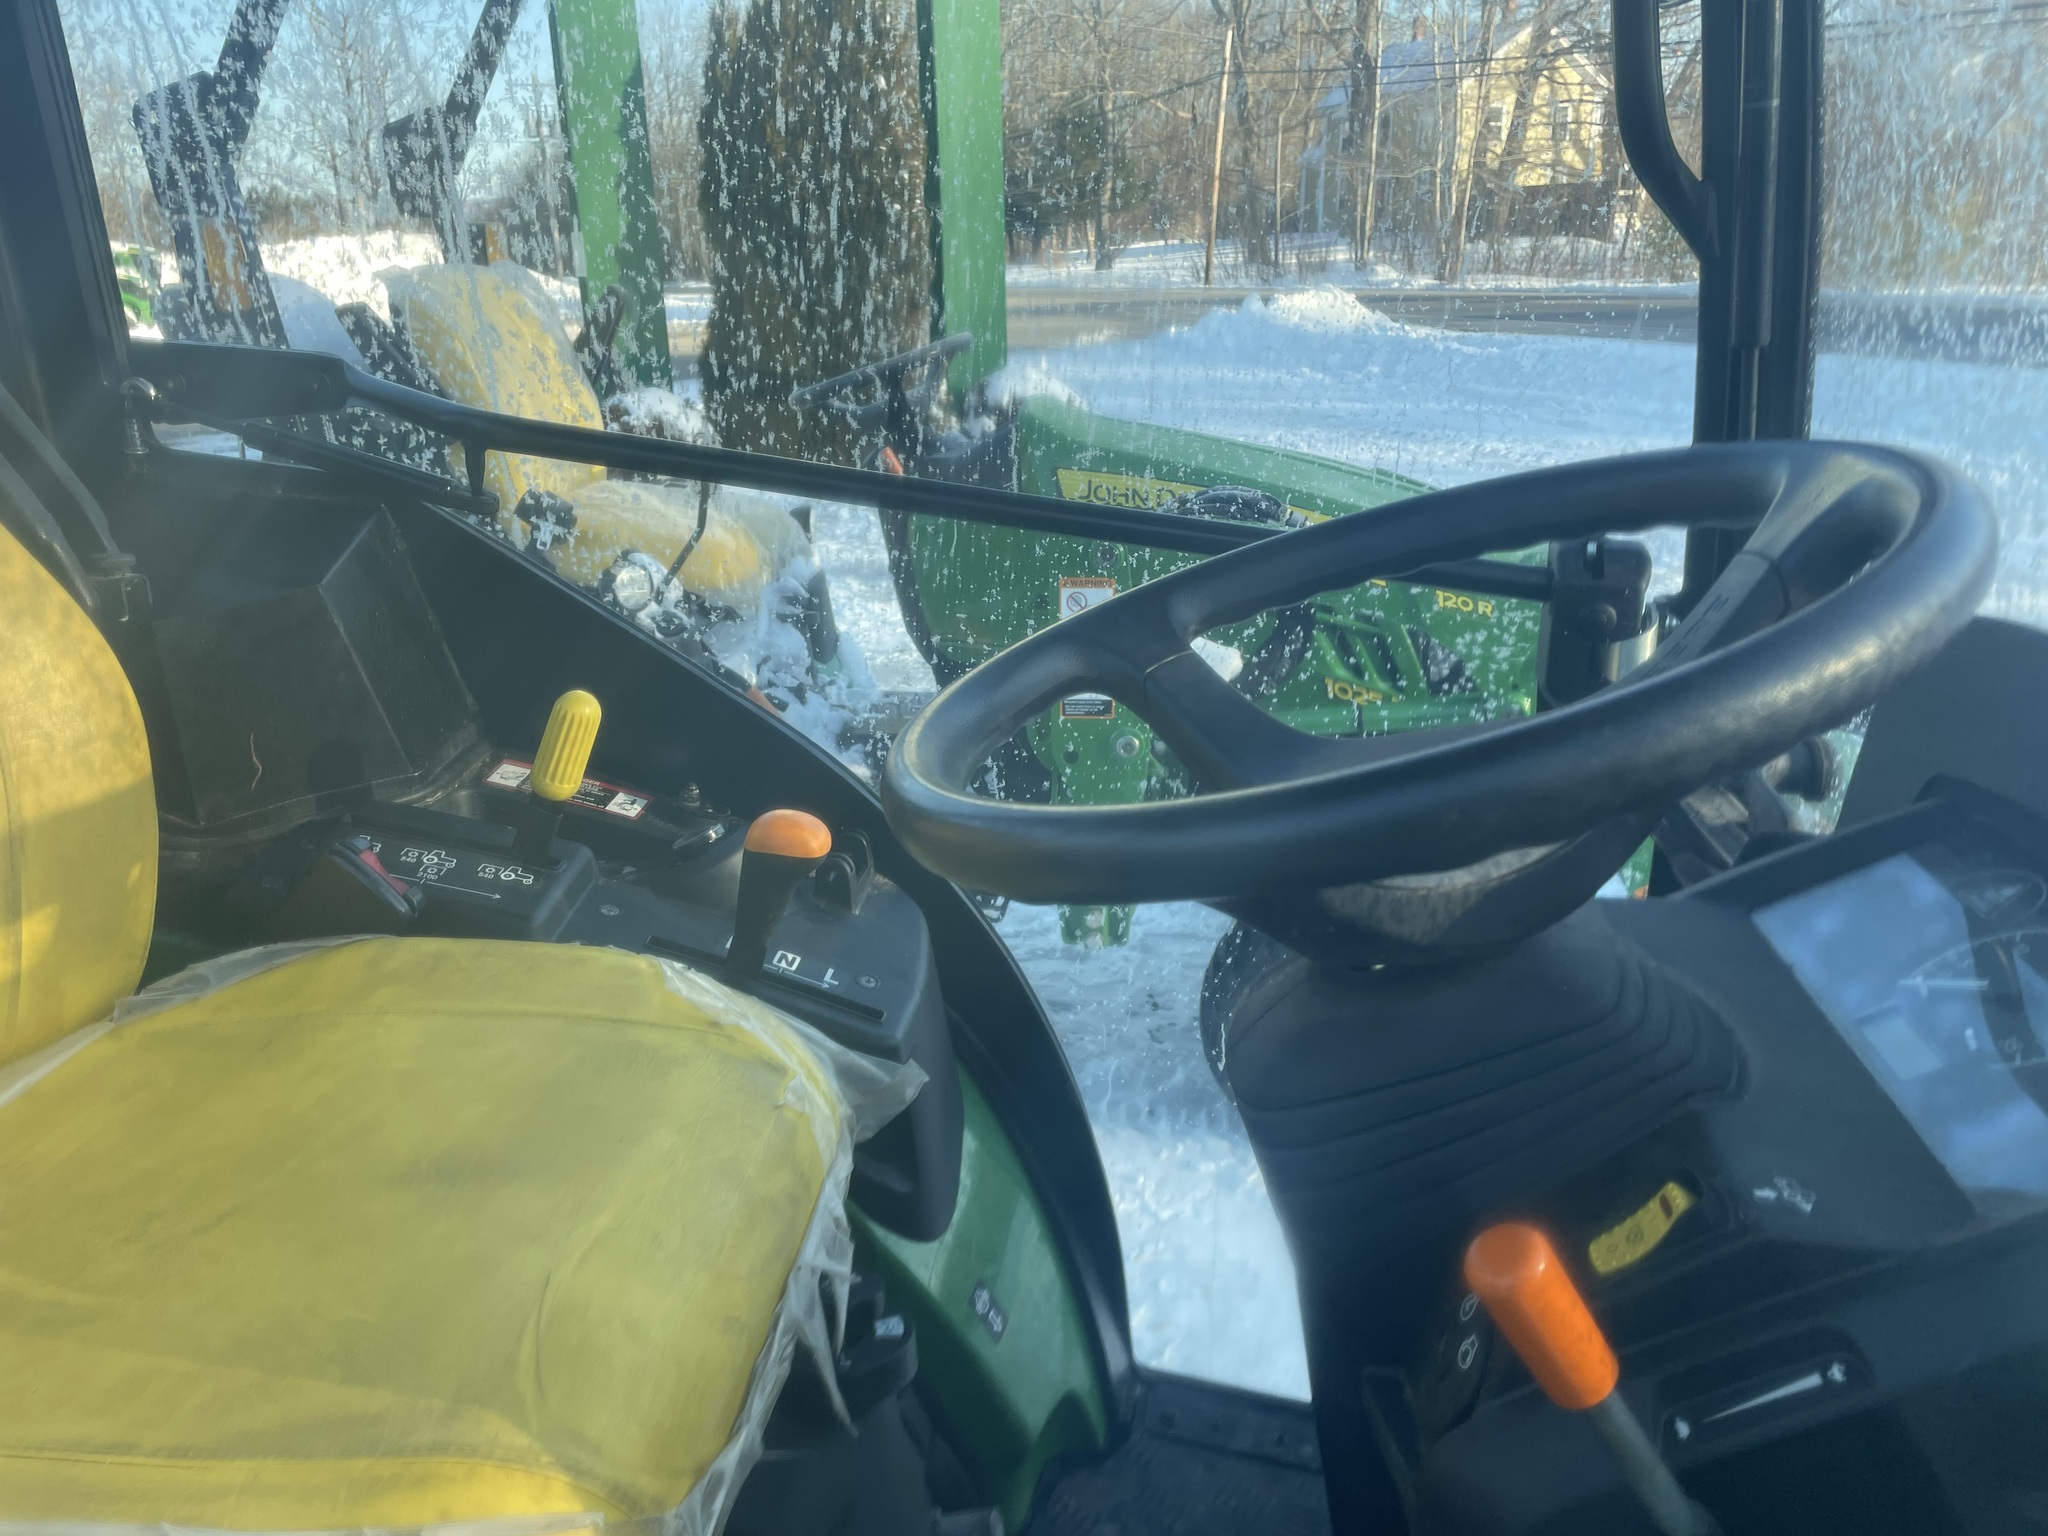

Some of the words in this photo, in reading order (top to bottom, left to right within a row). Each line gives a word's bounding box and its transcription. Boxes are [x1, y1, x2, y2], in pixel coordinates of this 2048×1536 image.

[1078, 480, 1150, 508] JOHN
[416, 872, 439, 880] 2100
[776, 952, 798, 969] N
[823, 967, 840, 986] L
